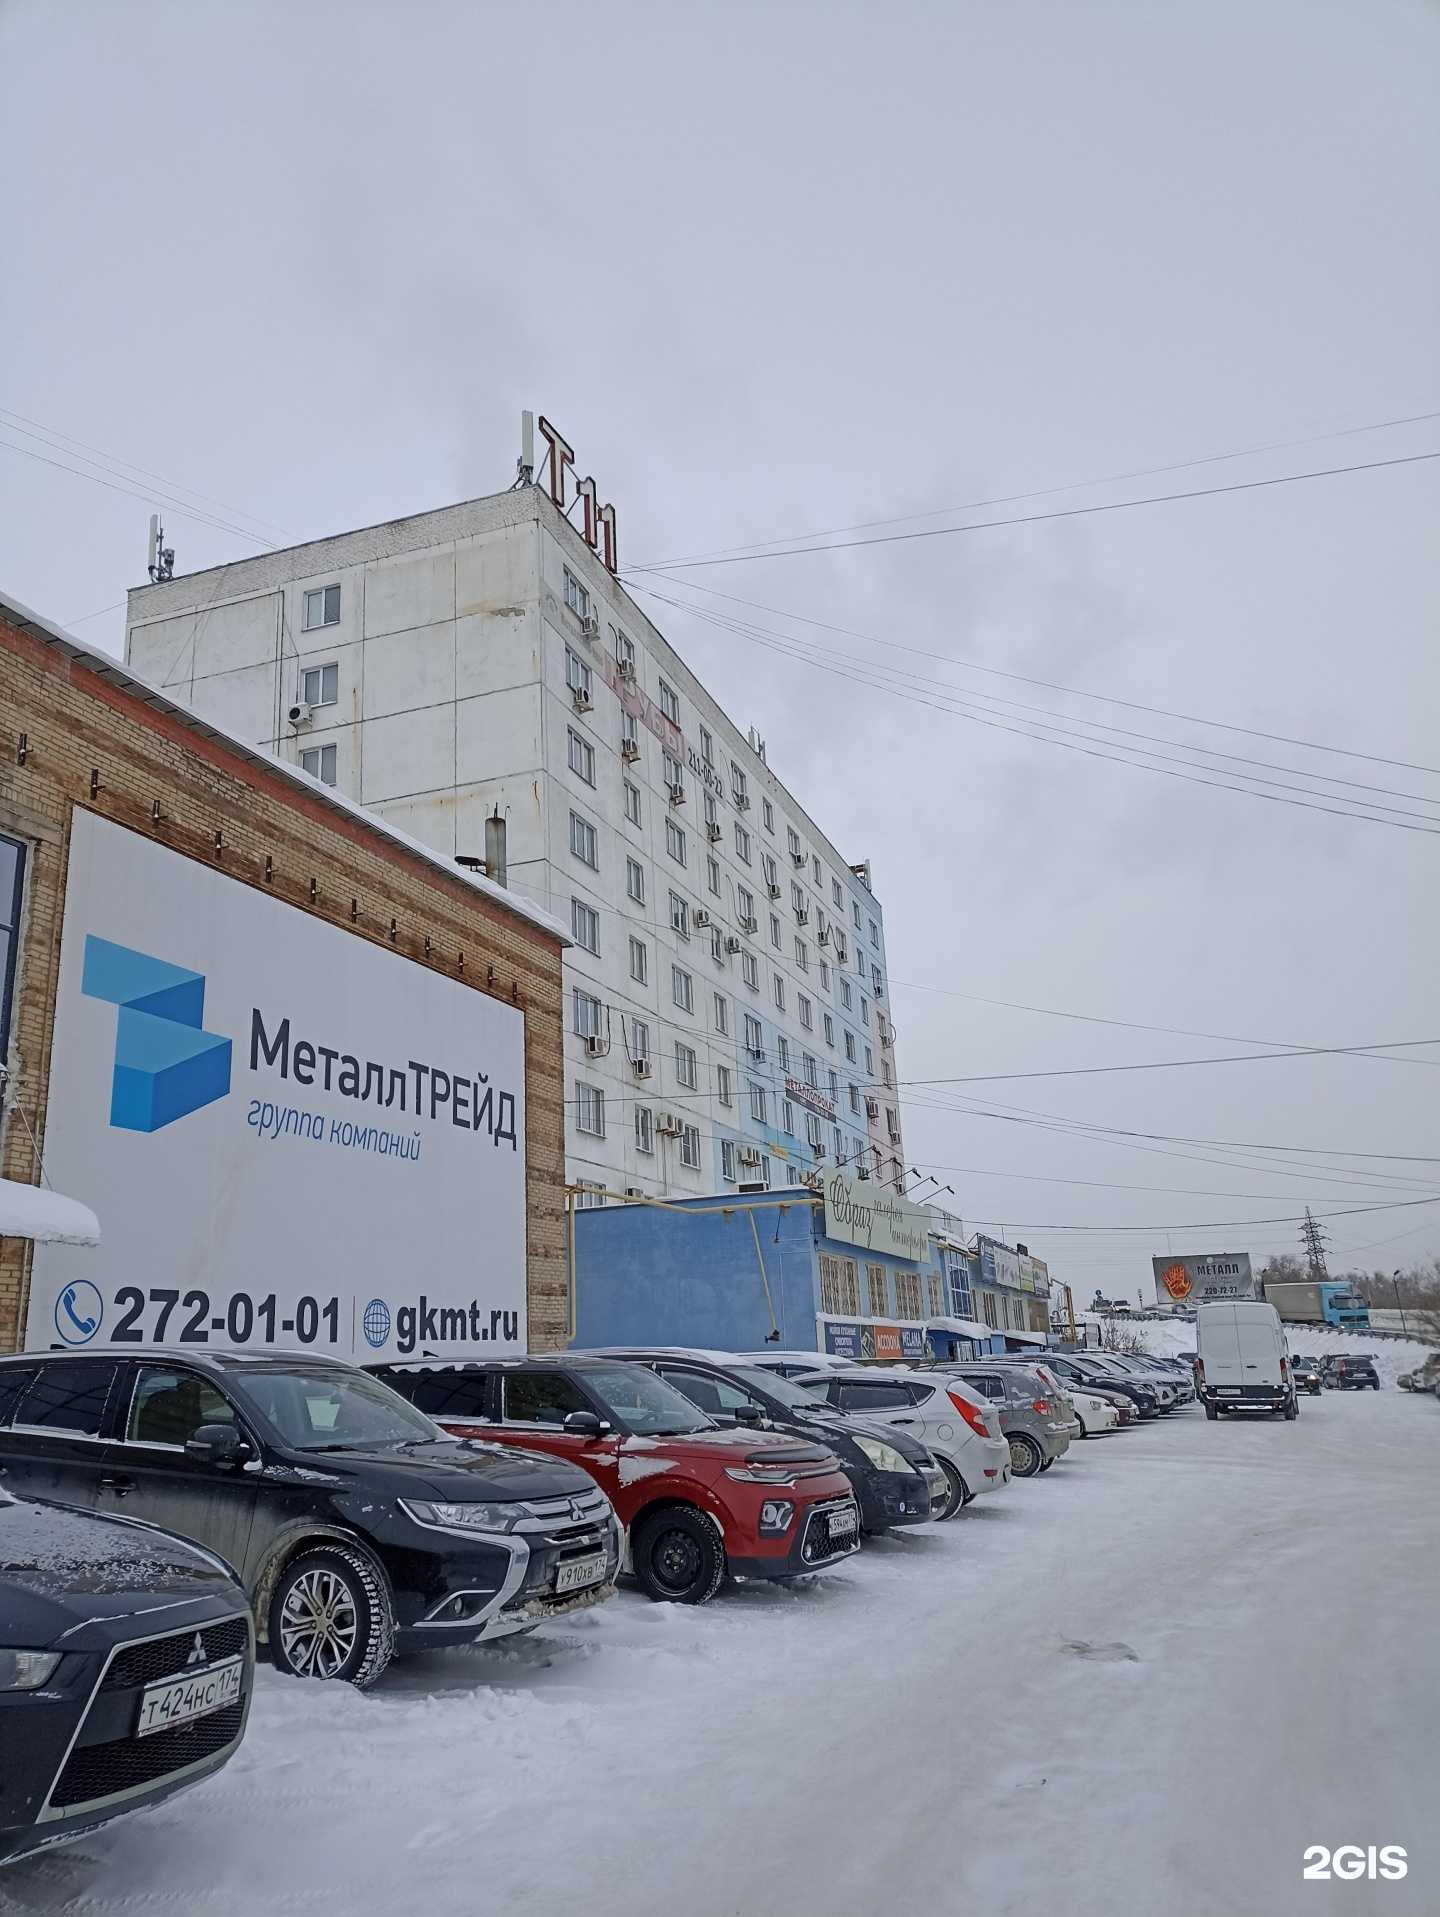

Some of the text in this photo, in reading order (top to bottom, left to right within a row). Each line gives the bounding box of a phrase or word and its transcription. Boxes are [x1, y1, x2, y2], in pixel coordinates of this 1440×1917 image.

[249, 1008, 517, 1151] МеталлТРЕЙД
[247, 1100, 421, 1161] группа компаний
[1197, 1263, 1240, 1275] МЕТАЛЛ
[110, 1287, 339, 1343] 272-01-01
[397, 1296, 518, 1352] gkmt.ru
[148, 1667, 239, 1724] Т424НС 174
